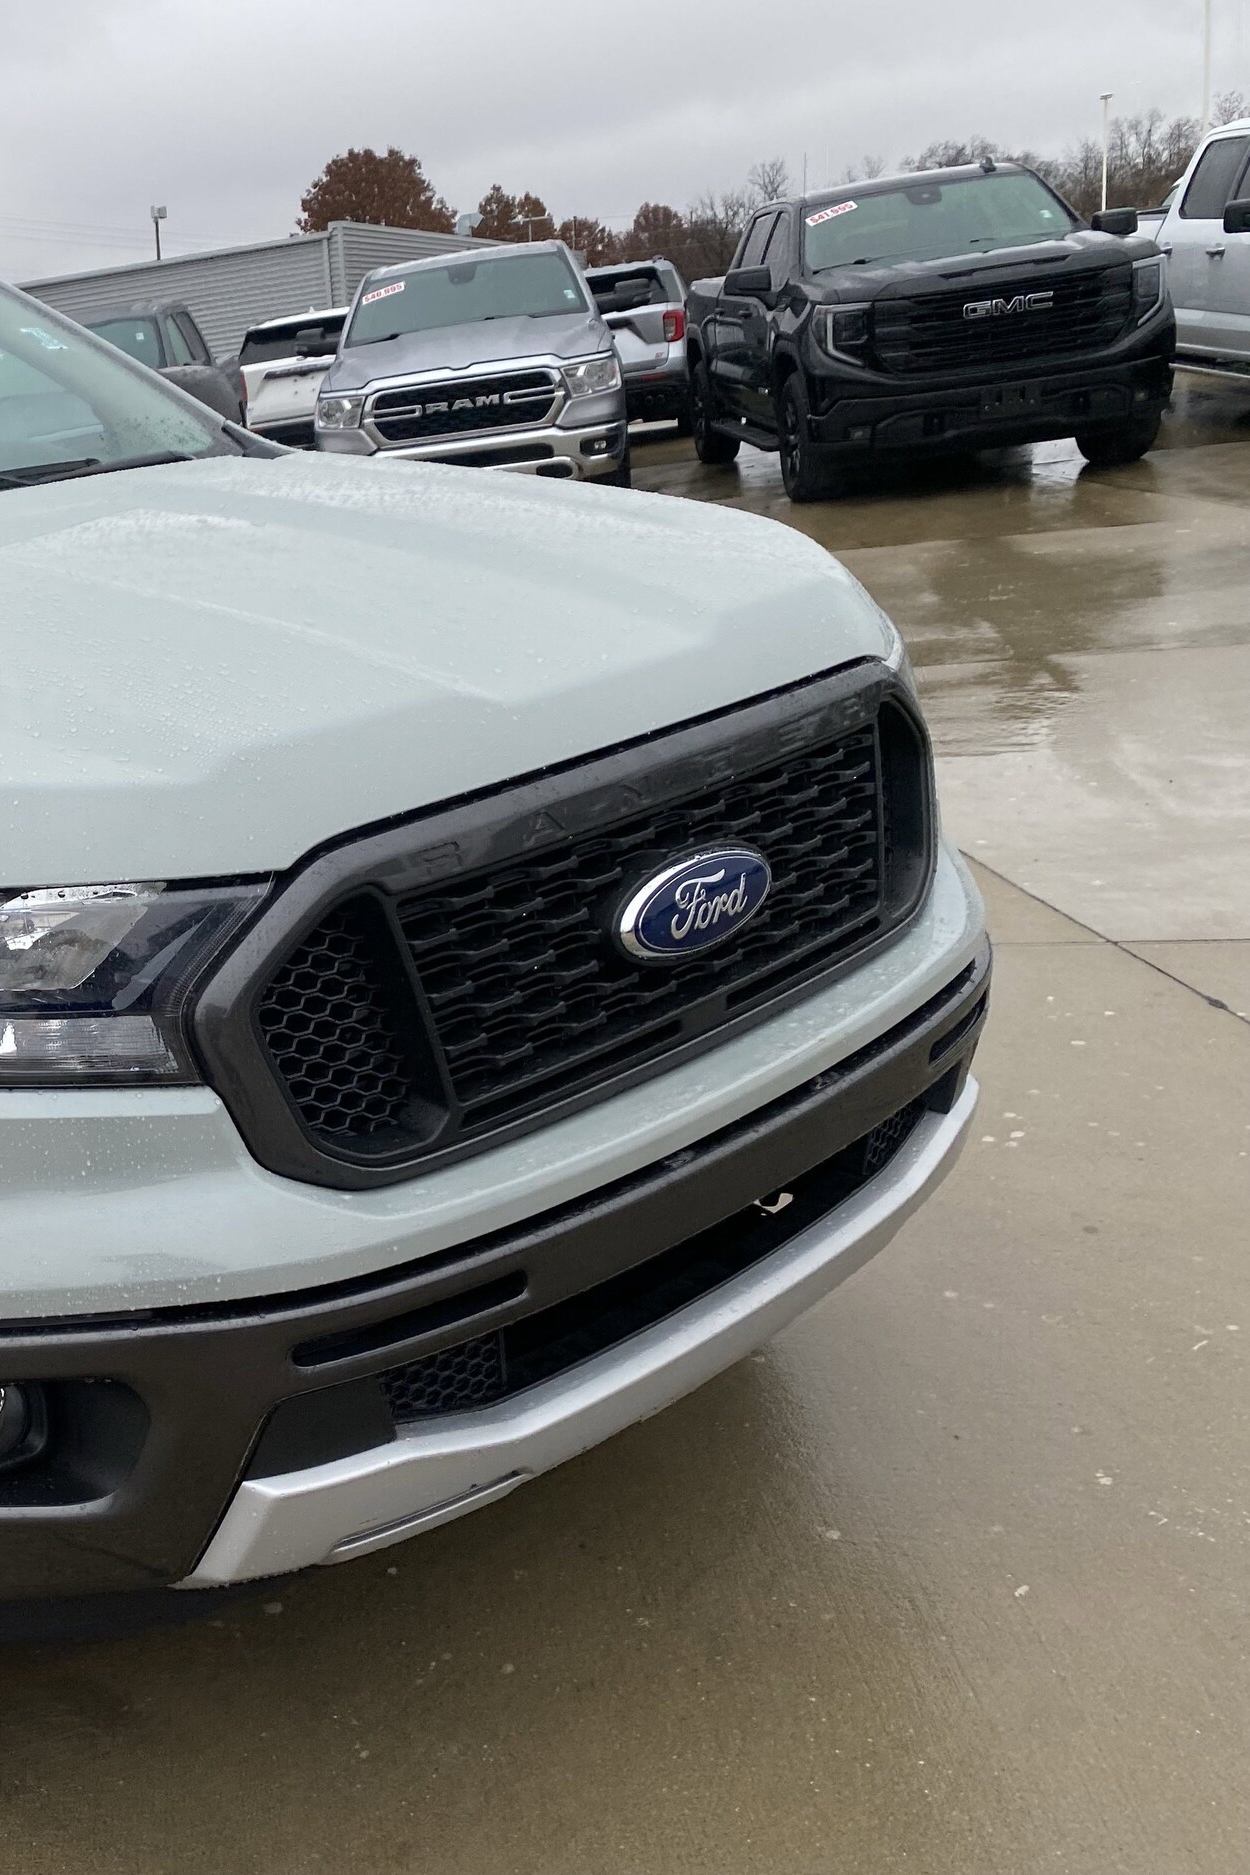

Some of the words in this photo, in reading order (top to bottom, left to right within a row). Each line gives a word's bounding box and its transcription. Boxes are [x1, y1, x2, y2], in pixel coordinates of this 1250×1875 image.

[963, 291, 1054, 319] GMC
[425, 394, 500, 414] RAM
[670, 868, 748, 940] Ford
